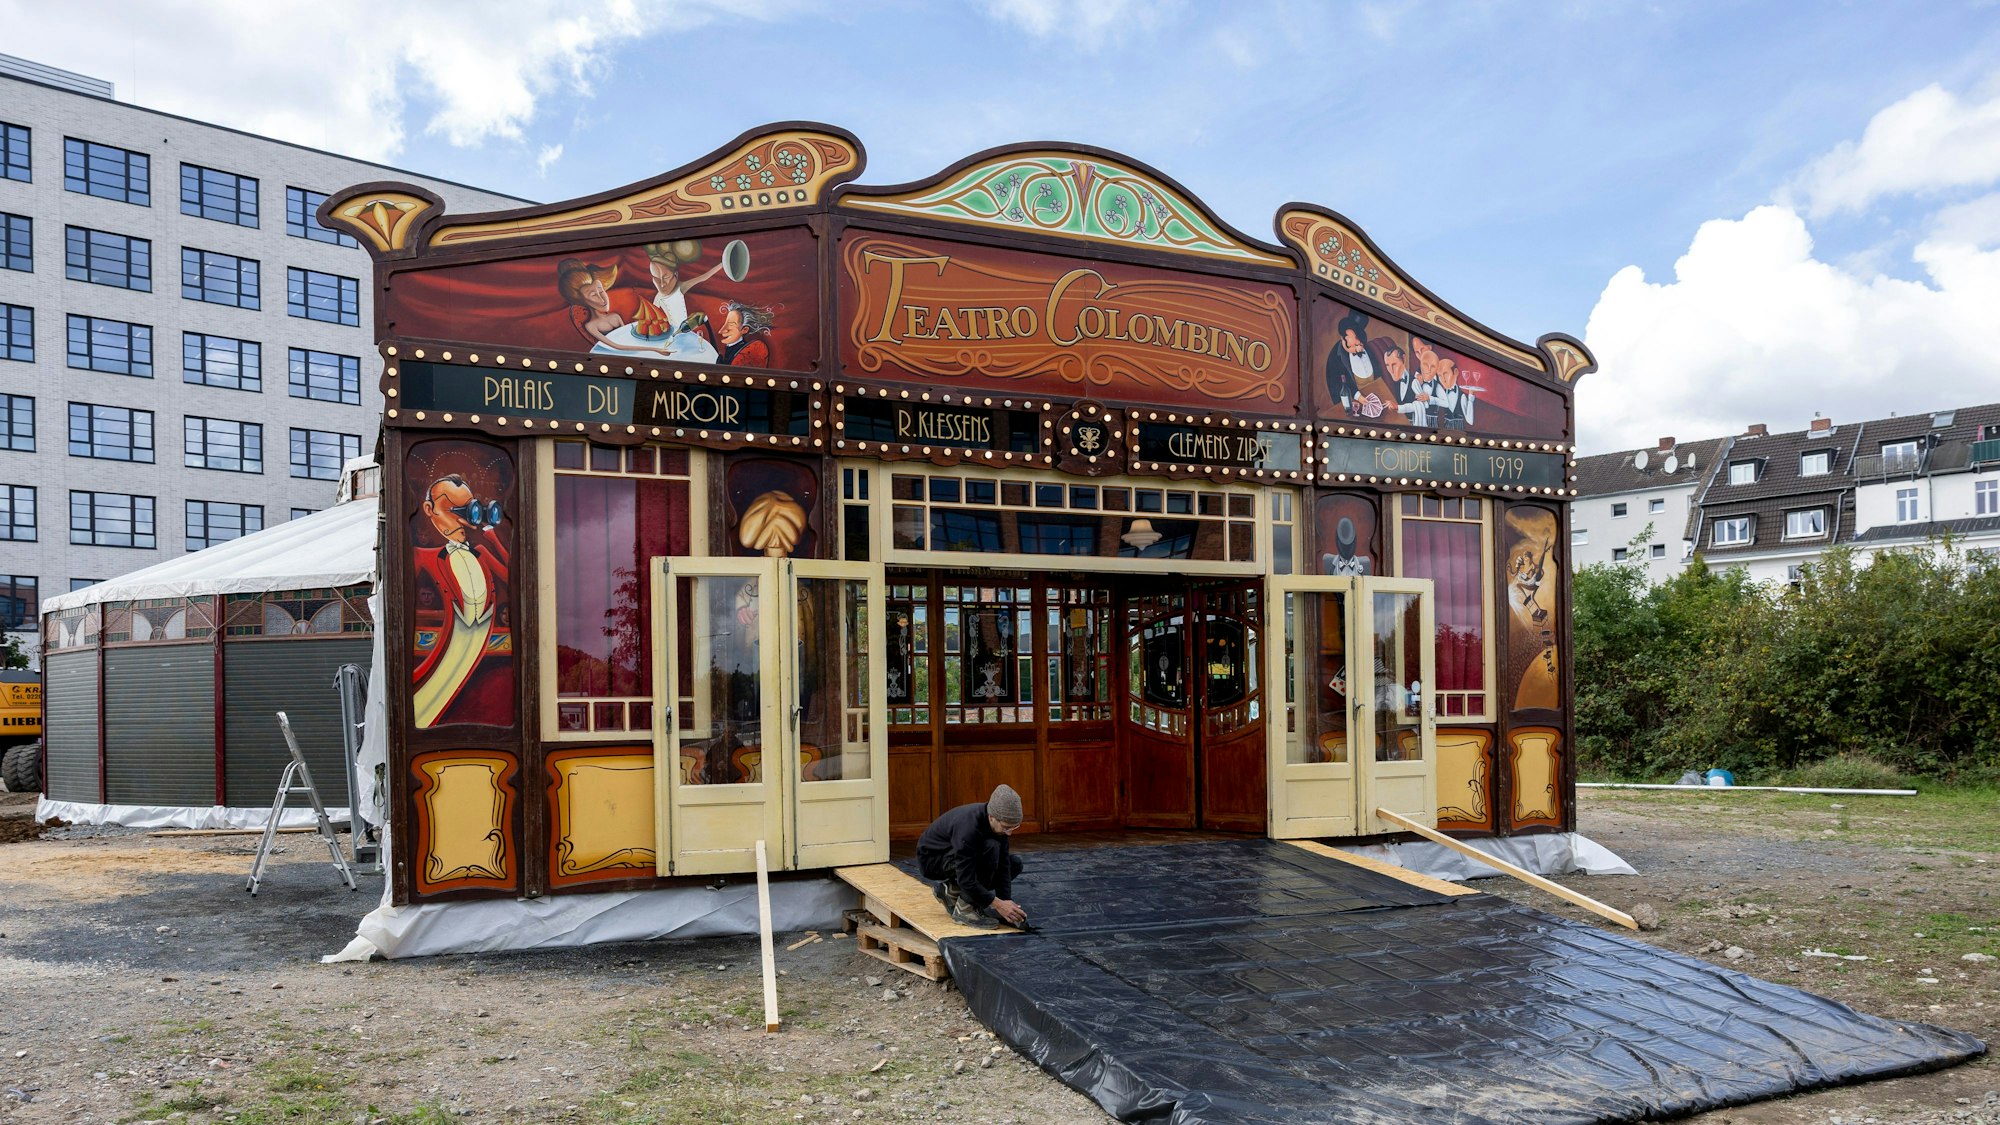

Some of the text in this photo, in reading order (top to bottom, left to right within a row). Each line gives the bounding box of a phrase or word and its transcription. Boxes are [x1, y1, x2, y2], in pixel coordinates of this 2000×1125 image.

[862, 249, 1272, 372] TEATRO COLOMBINO
[484, 376, 739, 425] PALAIS DU MIROIR
[1168, 432, 1272, 463] CLEMENS ZIPSE
[1374, 447, 1524, 480] FONDEE EN 1919
